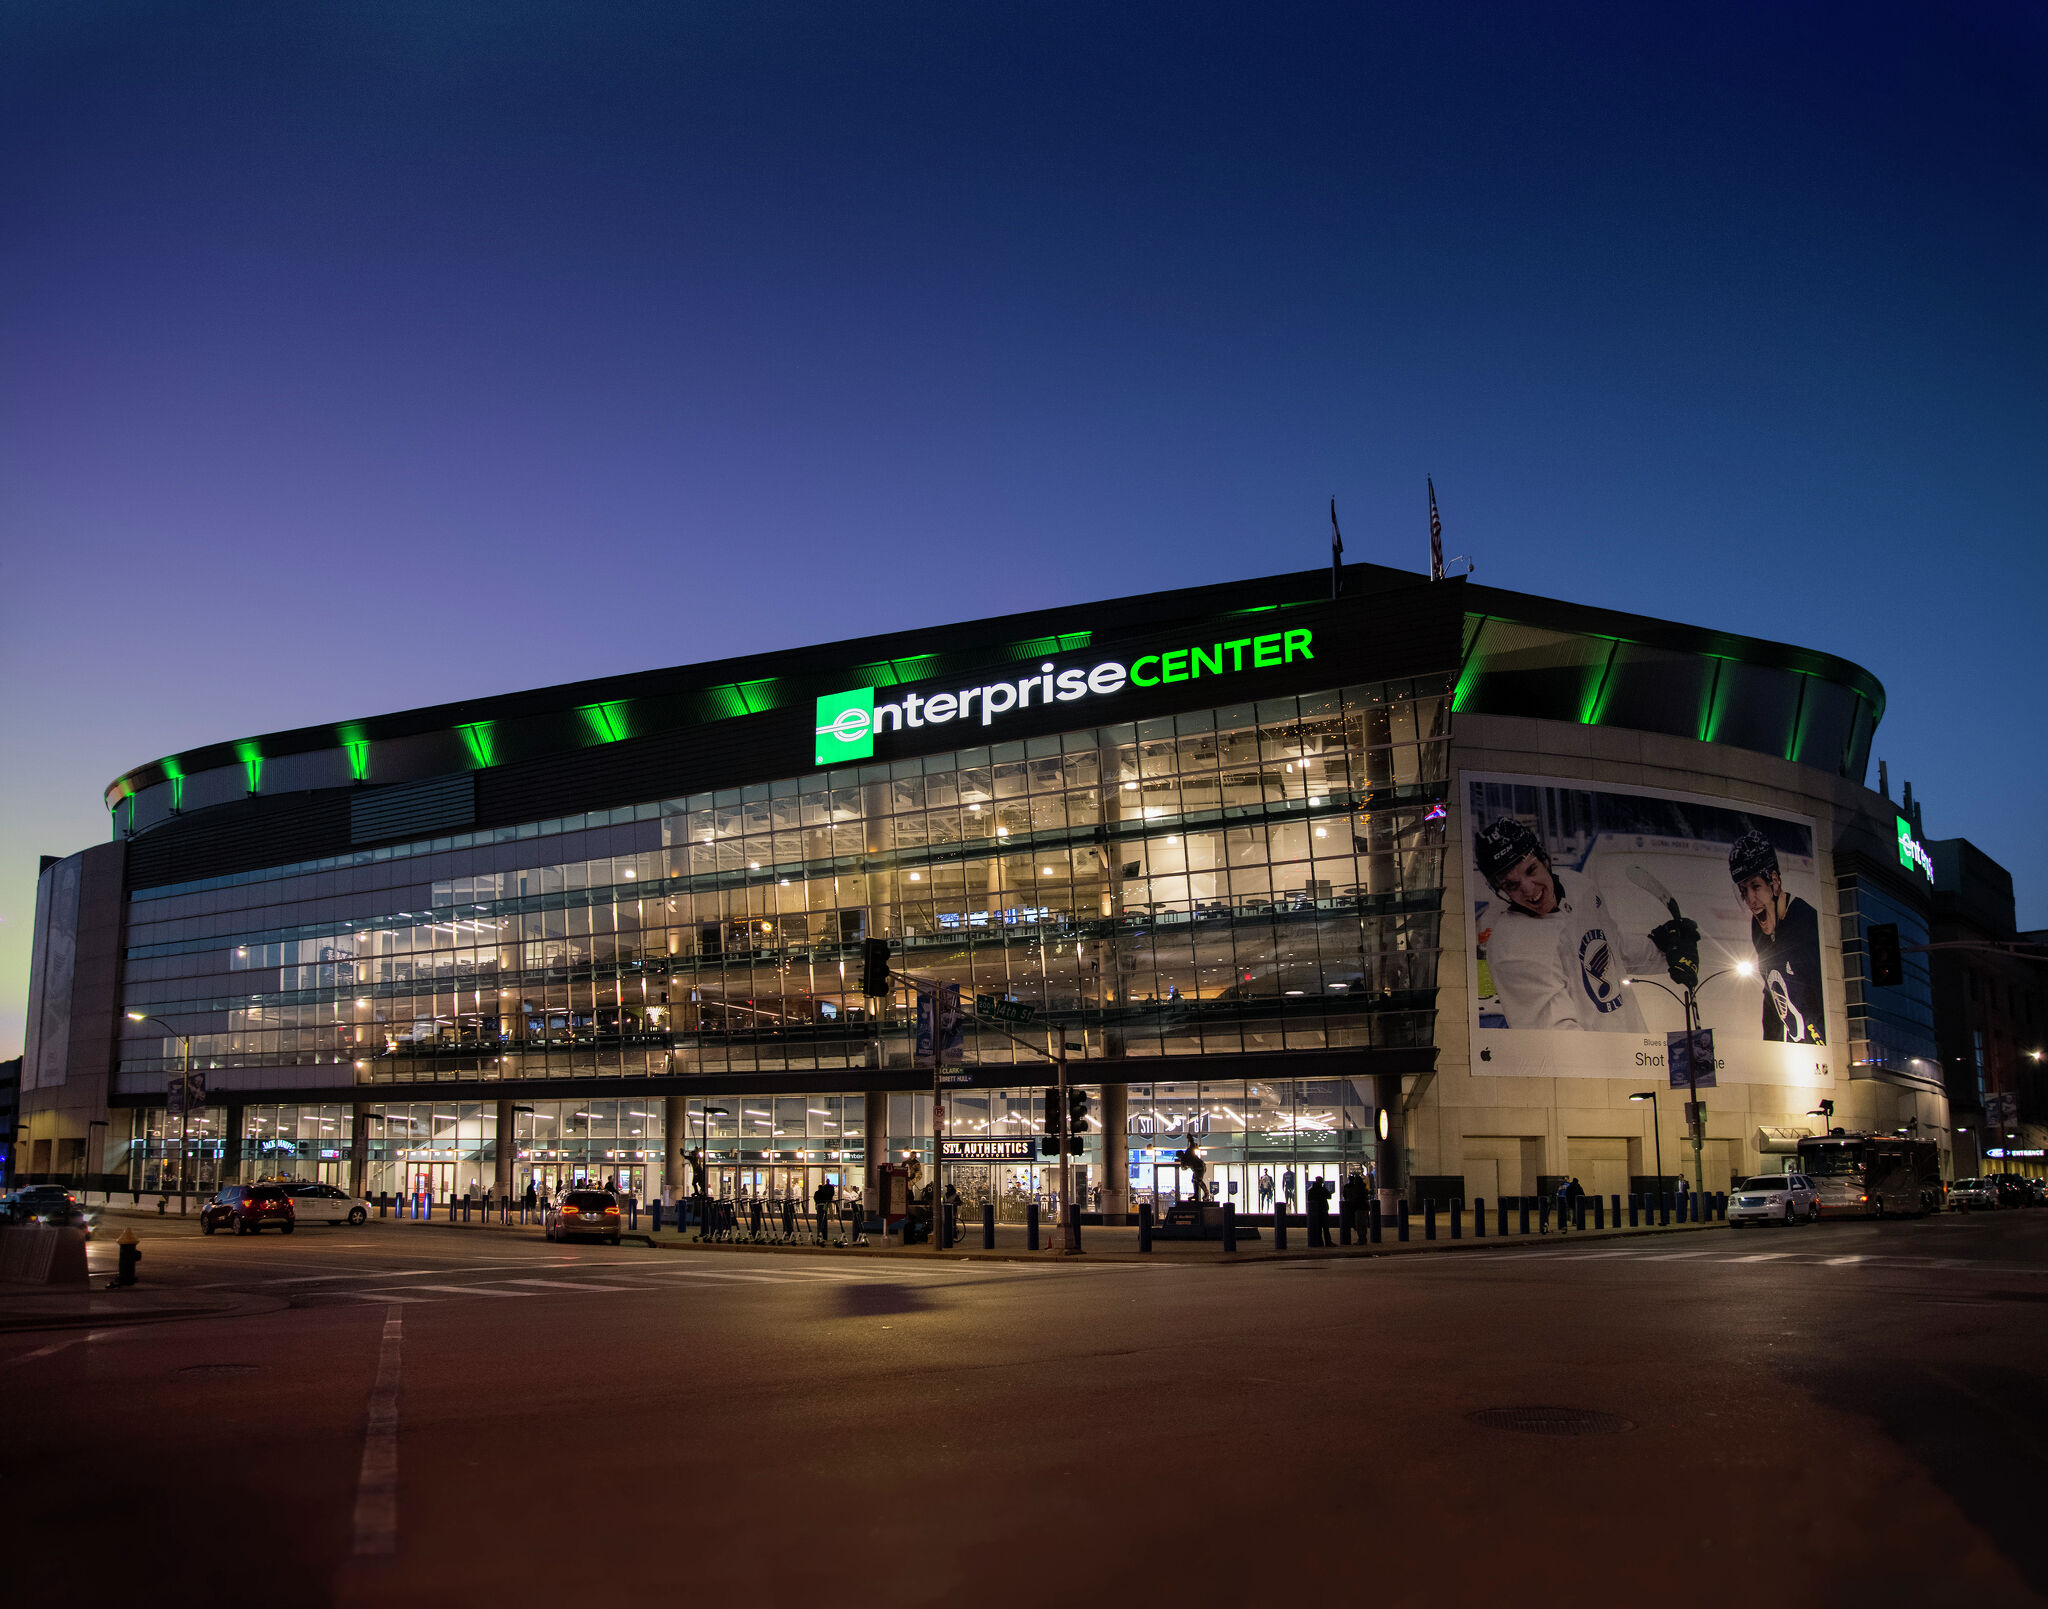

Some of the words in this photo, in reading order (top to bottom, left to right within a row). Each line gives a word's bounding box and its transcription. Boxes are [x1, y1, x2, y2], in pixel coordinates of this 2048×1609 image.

[816, 662, 1127, 742] enterprise
[1129, 628, 1314, 688] CENTER
[1643, 1038, 1662, 1047] Blues
[1635, 1052, 1665, 1067] Shot
[942, 1142, 962, 1154] STL
[963, 1142, 1029, 1154] AUTHENTICS
[2011, 1149, 2046, 1158] ENTRANCE
